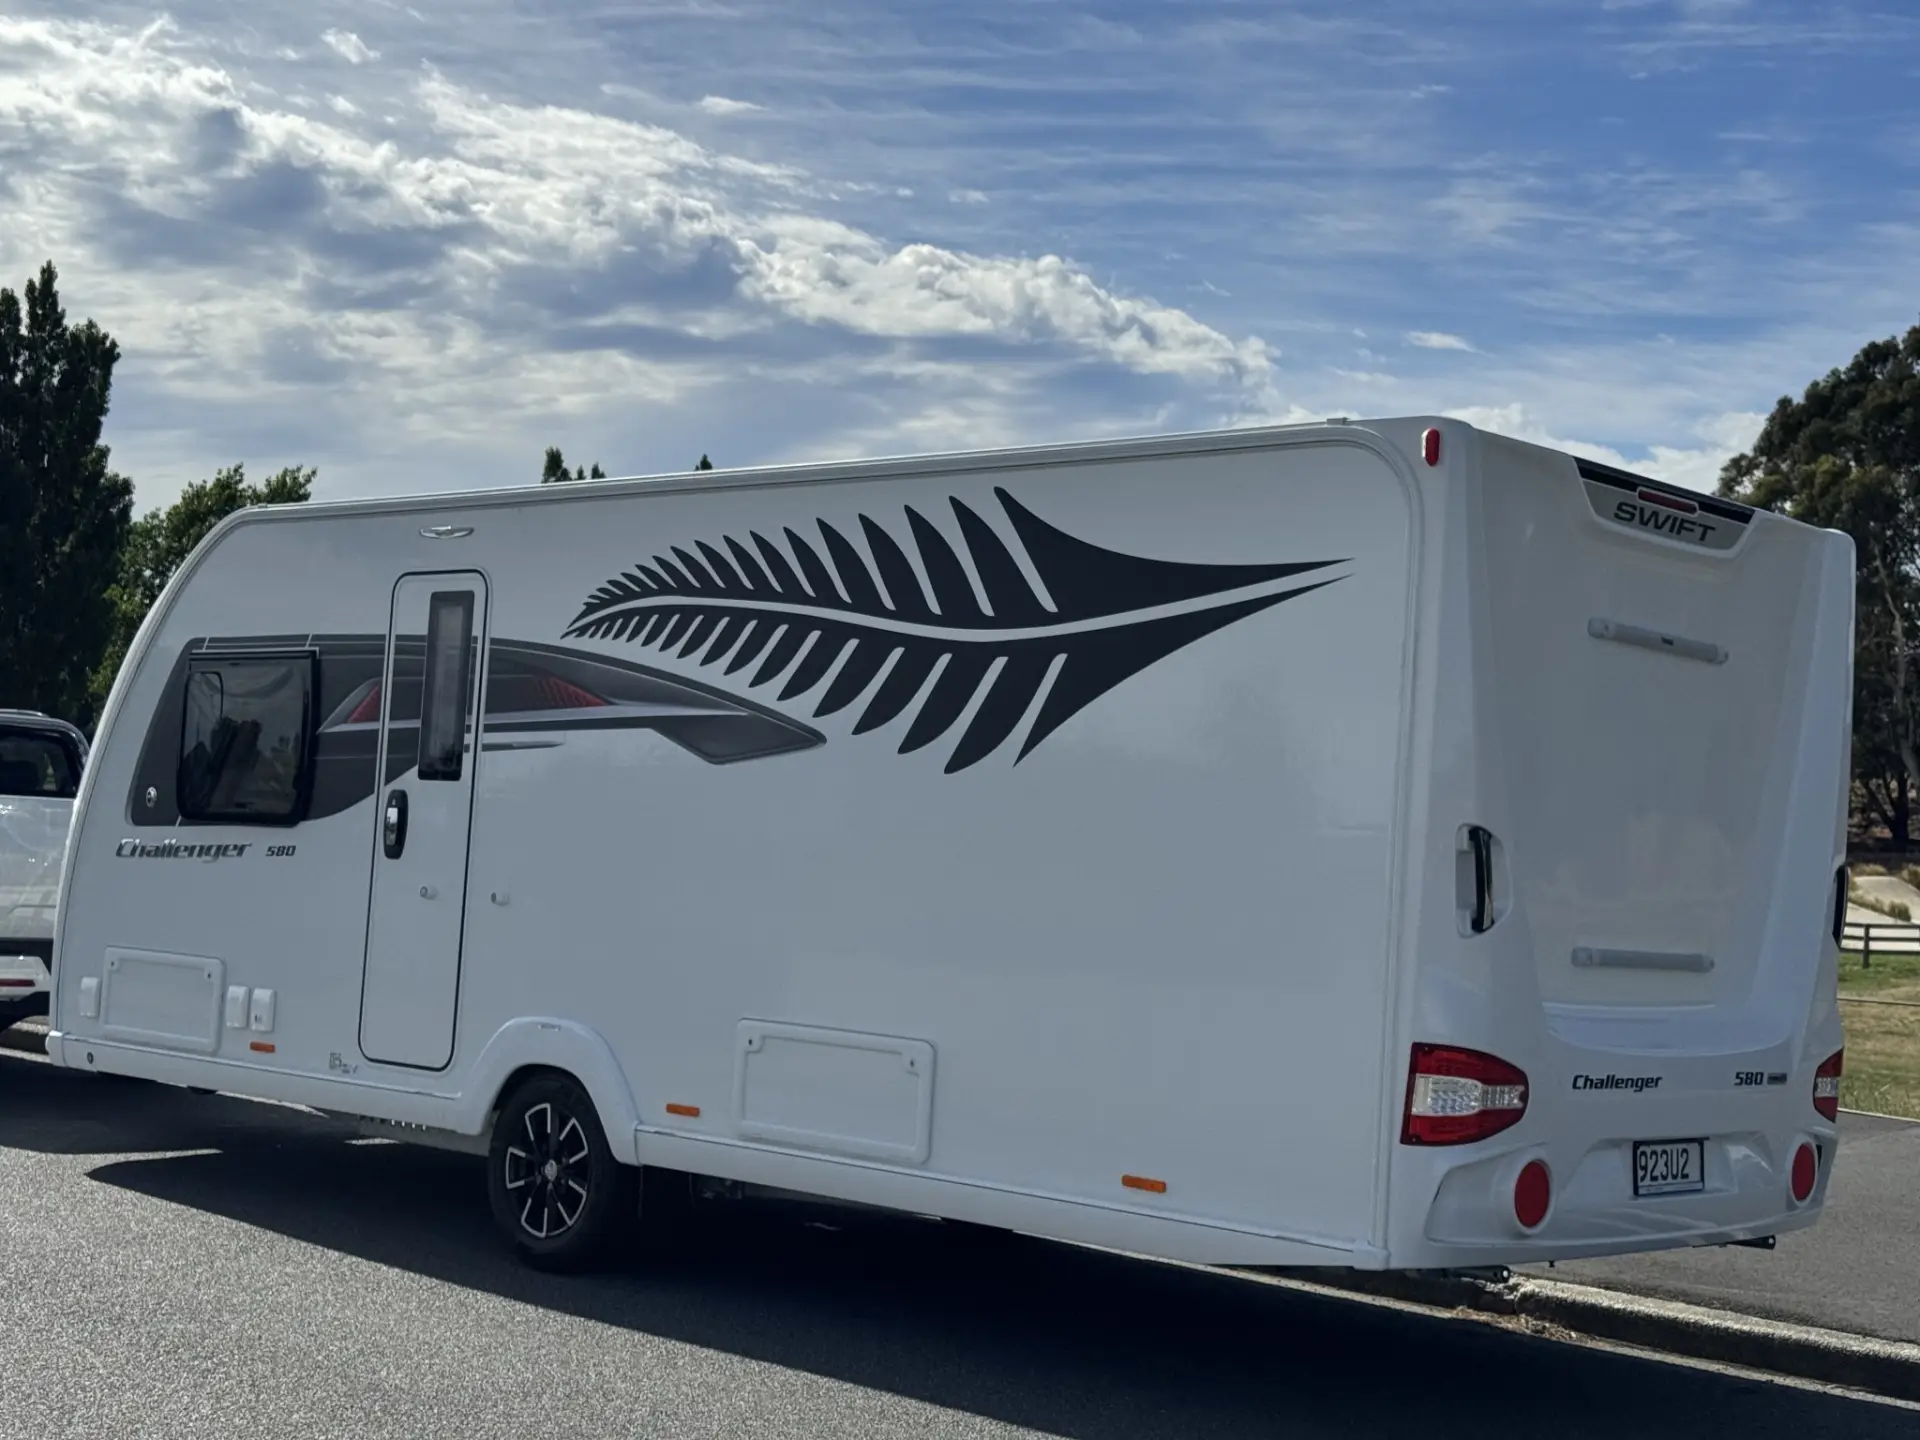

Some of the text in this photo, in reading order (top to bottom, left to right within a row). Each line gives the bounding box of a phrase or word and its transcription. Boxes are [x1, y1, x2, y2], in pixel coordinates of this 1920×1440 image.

[1613, 501, 1716, 541] SWIFT
[115, 838, 296, 864] Challenger 580
[1571, 1074, 1663, 1093] Challenger
[1734, 1071, 1764, 1086] 580
[1639, 1147, 1689, 1183] 923U2
